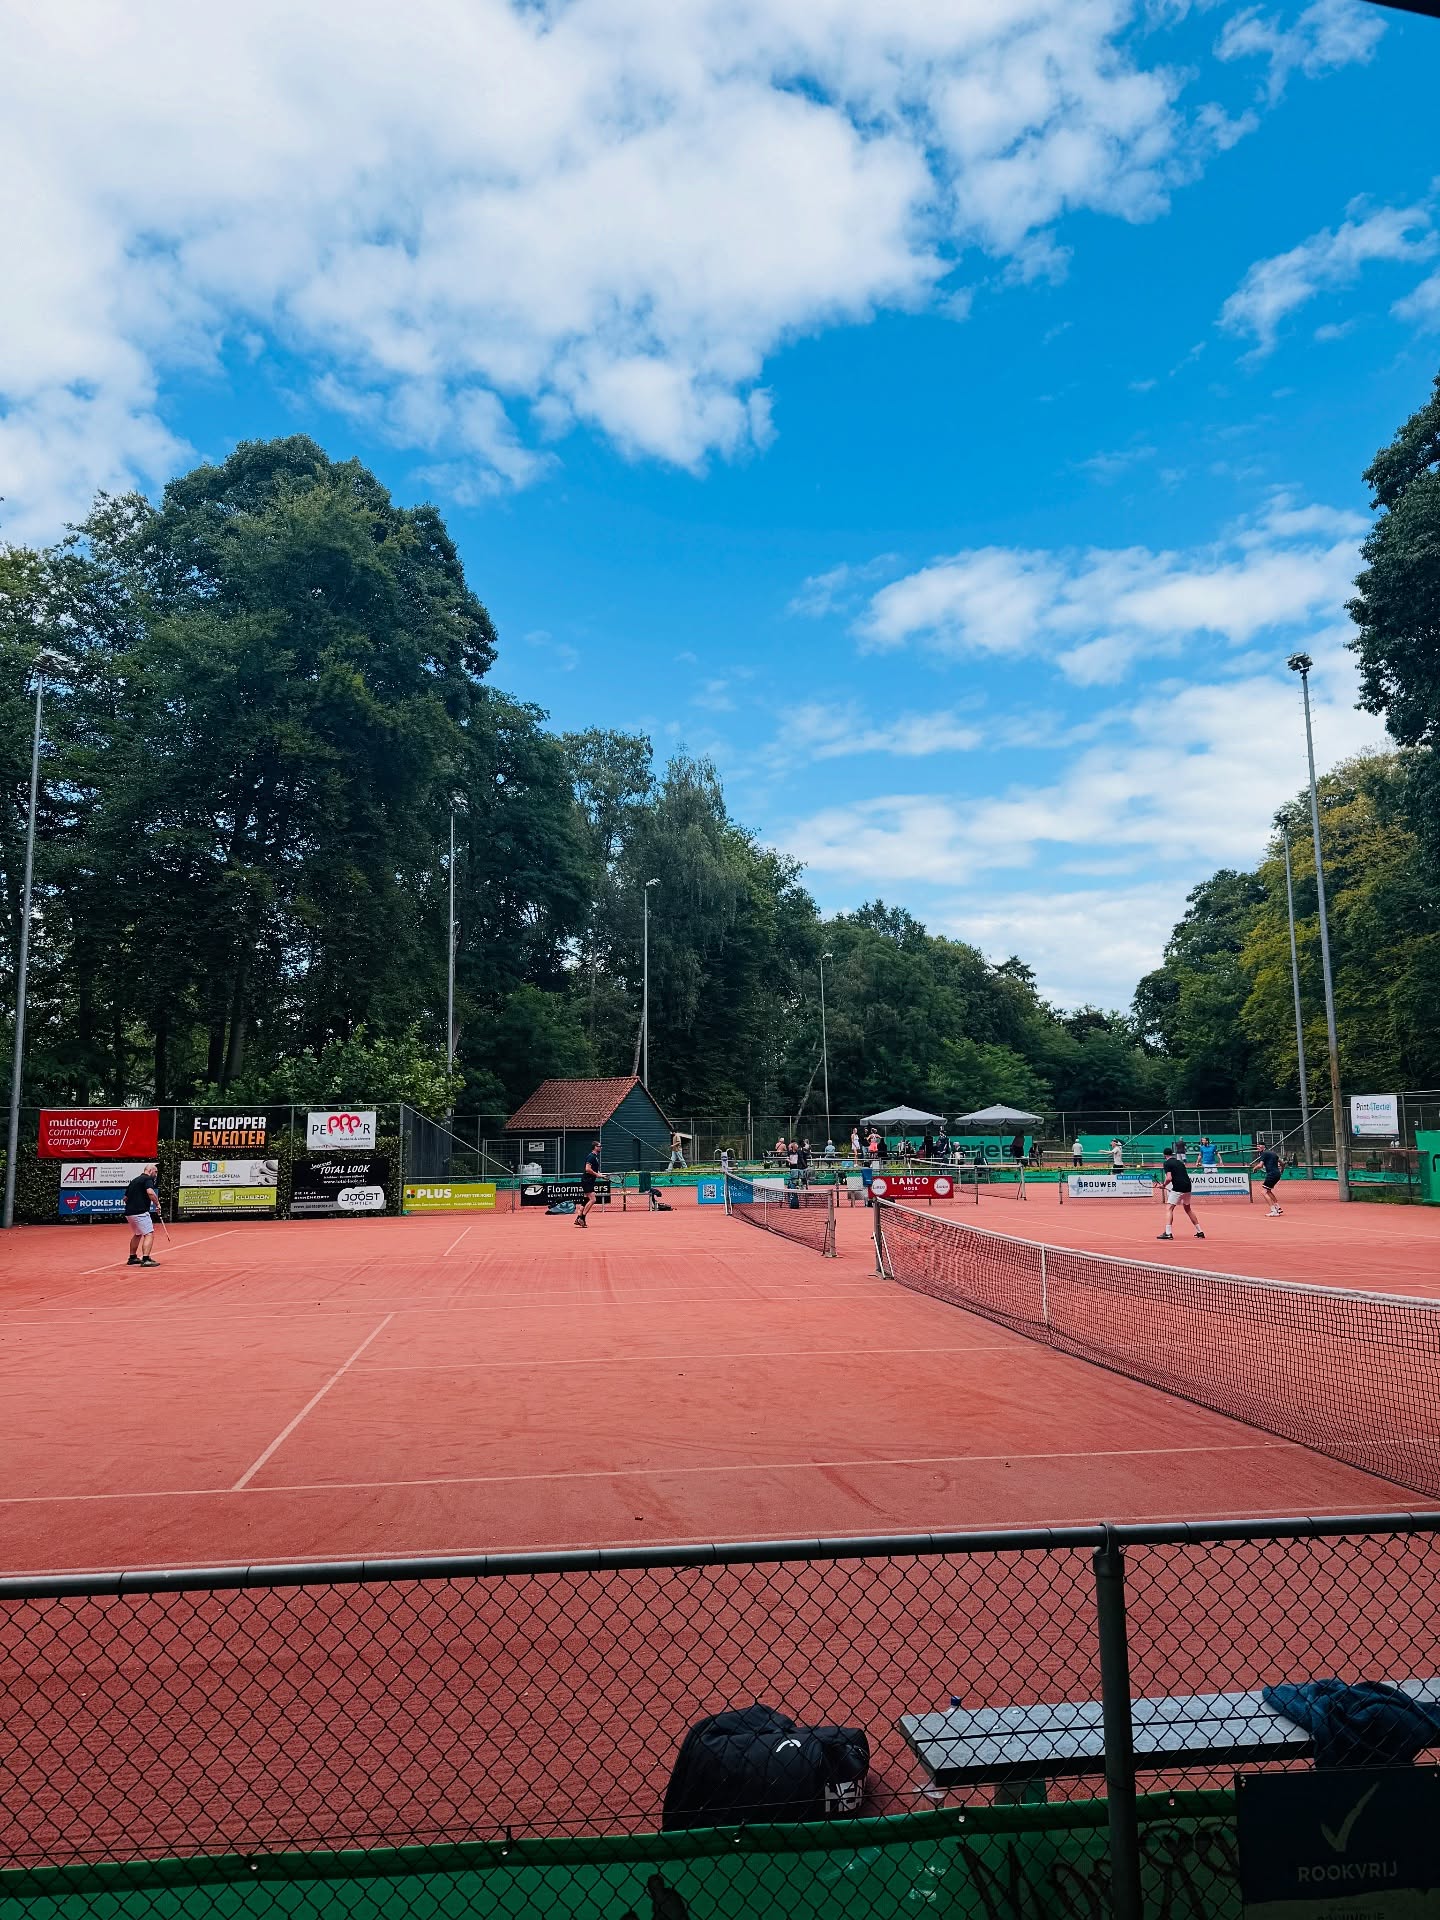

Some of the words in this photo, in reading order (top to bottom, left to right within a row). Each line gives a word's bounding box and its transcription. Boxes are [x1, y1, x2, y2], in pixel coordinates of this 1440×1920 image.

[49, 1118, 100, 1128] multicopy
[102, 1118, 118, 1126] the
[194, 1116, 266, 1130] E-CHOPPER
[48, 1128, 122, 1136] communication
[48, 1138, 92, 1148] company
[192, 1130, 266, 1146] DEVENTER
[64, 1166, 98, 1180] ARAT
[320, 1166, 344, 1174] TOTAL
[347, 1164, 370, 1174] LOOK
[417, 1189, 452, 1198] PLUS
[1297, 1861, 1398, 1882] ROOKVRIJ
